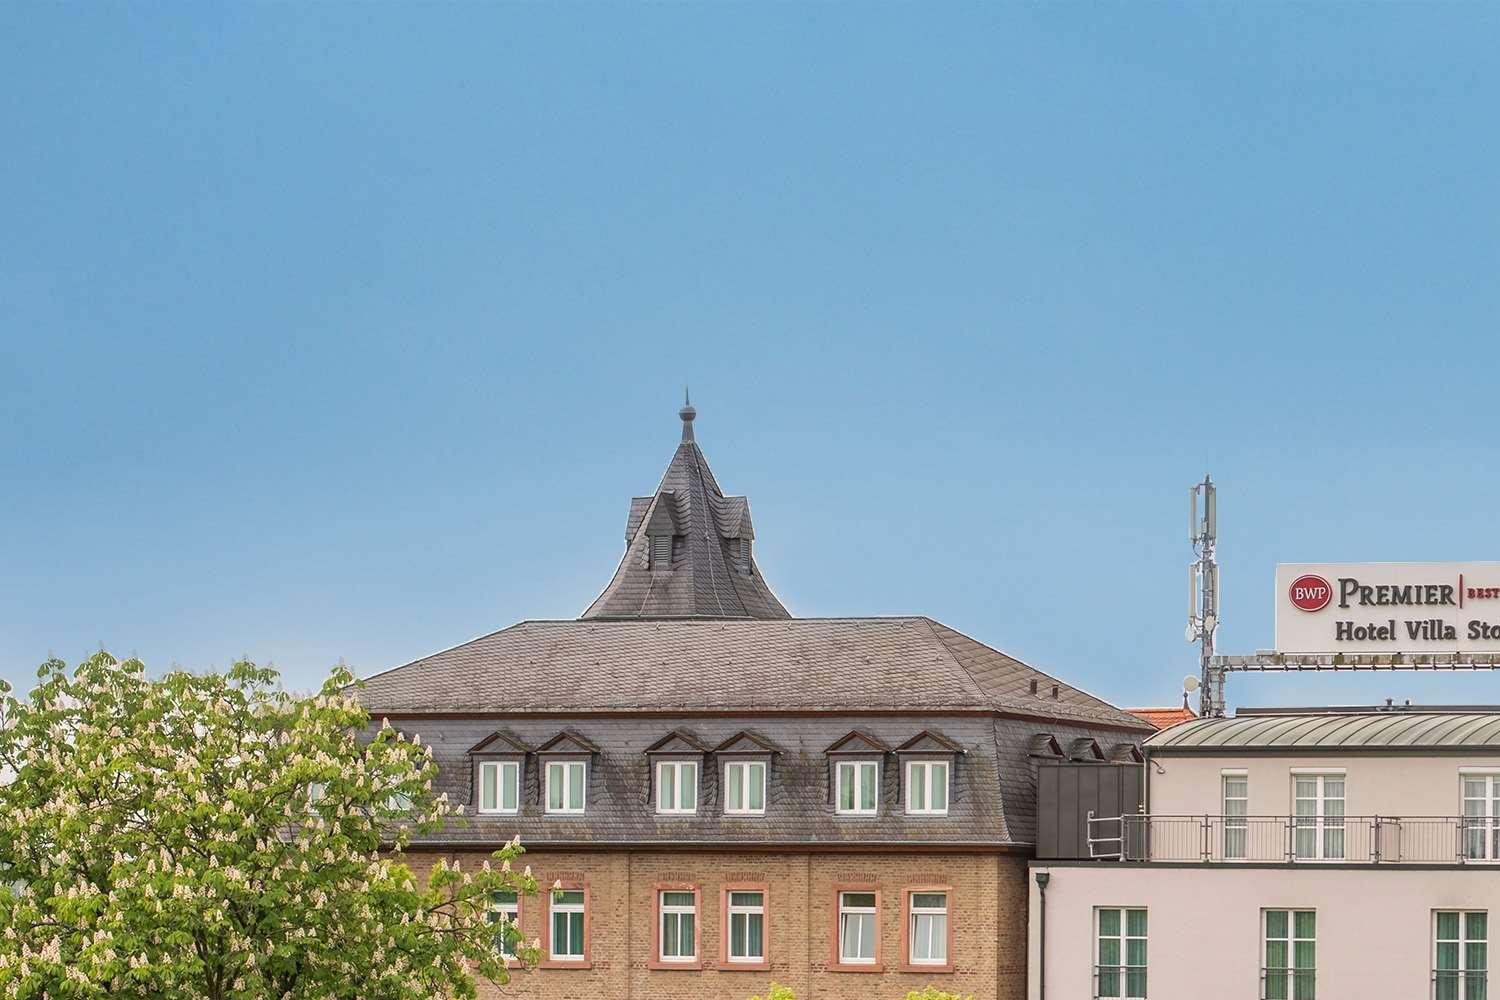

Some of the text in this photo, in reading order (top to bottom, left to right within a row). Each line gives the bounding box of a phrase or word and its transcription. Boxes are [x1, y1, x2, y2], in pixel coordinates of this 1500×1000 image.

[1295, 587, 1326, 600] BWP
[1338, 578, 1456, 608] PREMIER
[1466, 587, 1500, 599] BEST
[1335, 620, 1397, 641] Hotel
[1404, 619, 1457, 640] Villa
